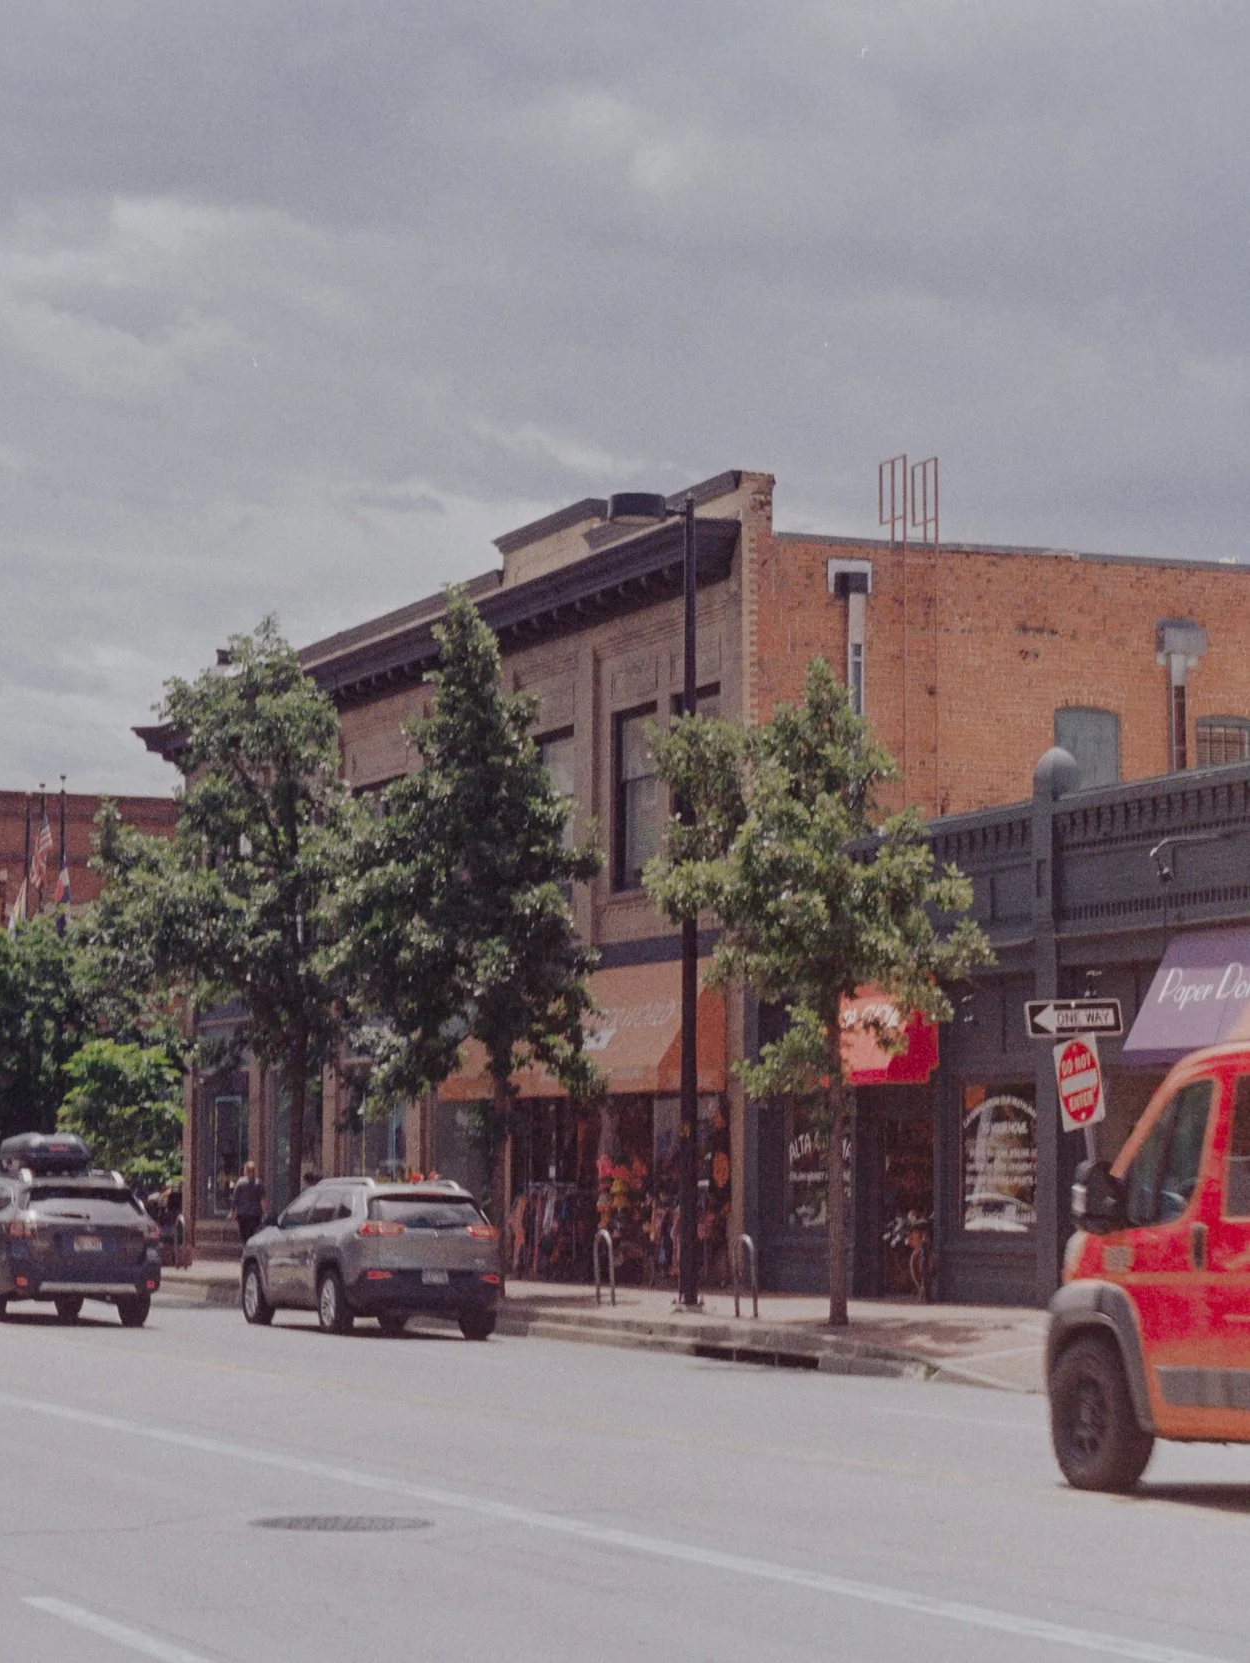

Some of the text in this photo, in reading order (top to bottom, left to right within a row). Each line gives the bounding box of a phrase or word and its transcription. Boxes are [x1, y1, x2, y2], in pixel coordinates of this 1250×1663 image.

[1157, 966, 1214, 1011] Paper
[1056, 1011, 1110, 1027] ONE WAY
[1061, 1052, 1091, 1077] DO NOT
[1069, 1089, 1095, 1113] ENTER
[789, 1132, 812, 1165] ALTA
